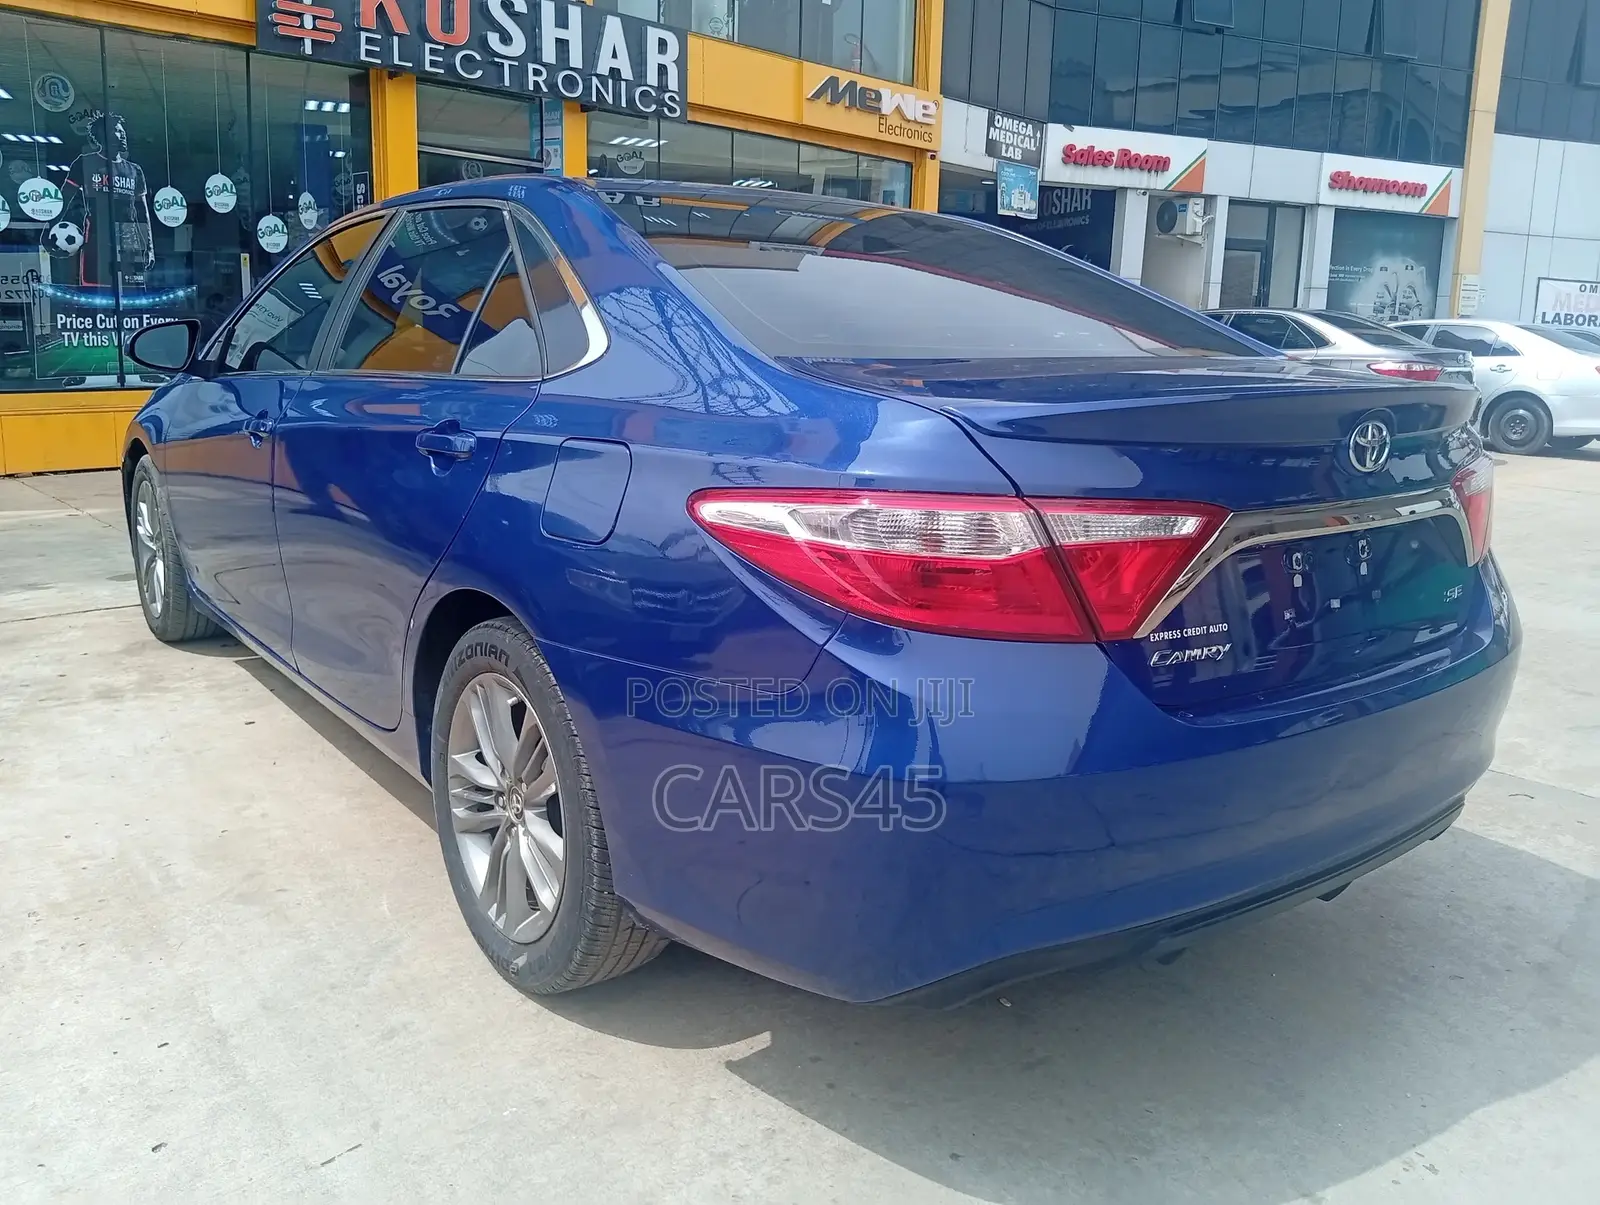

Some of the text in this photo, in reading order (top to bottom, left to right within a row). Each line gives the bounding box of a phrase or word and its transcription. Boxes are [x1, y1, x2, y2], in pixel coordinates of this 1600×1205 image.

[360, 31, 681, 118] ELECTRONICS
[878, 117, 934, 143] Electronics
[994, 113, 1033, 137] OMEGA
[989, 127, 1037, 151] MEDICAL
[616, 151, 645, 162] GOAL
[1001, 144, 1023, 160] LAB
[1062, 144, 1171, 172] Sales Room
[102, 174, 136, 190] KSHAR
[1328, 171, 1428, 198] Showroom
[18, 187, 63, 204] GOAL
[205, 183, 237, 199] GOAL
[154, 196, 187, 212] GOAL
[1039, 188, 1092, 217] OSHAR
[257, 223, 289, 239] GOAL
[1579, 284, 1600, 295] OM
[57, 313, 93, 329] Price
[96, 313, 118, 329] Cut
[123, 316, 139, 329] on
[1541, 312, 1600, 328] LABOR
[62, 331, 80, 347] TV
[83, 331, 109, 347] this
[1150, 622, 1229, 642] EXPRESS CREDIT AUTO
[1149, 642, 1233, 668] CAMRY
